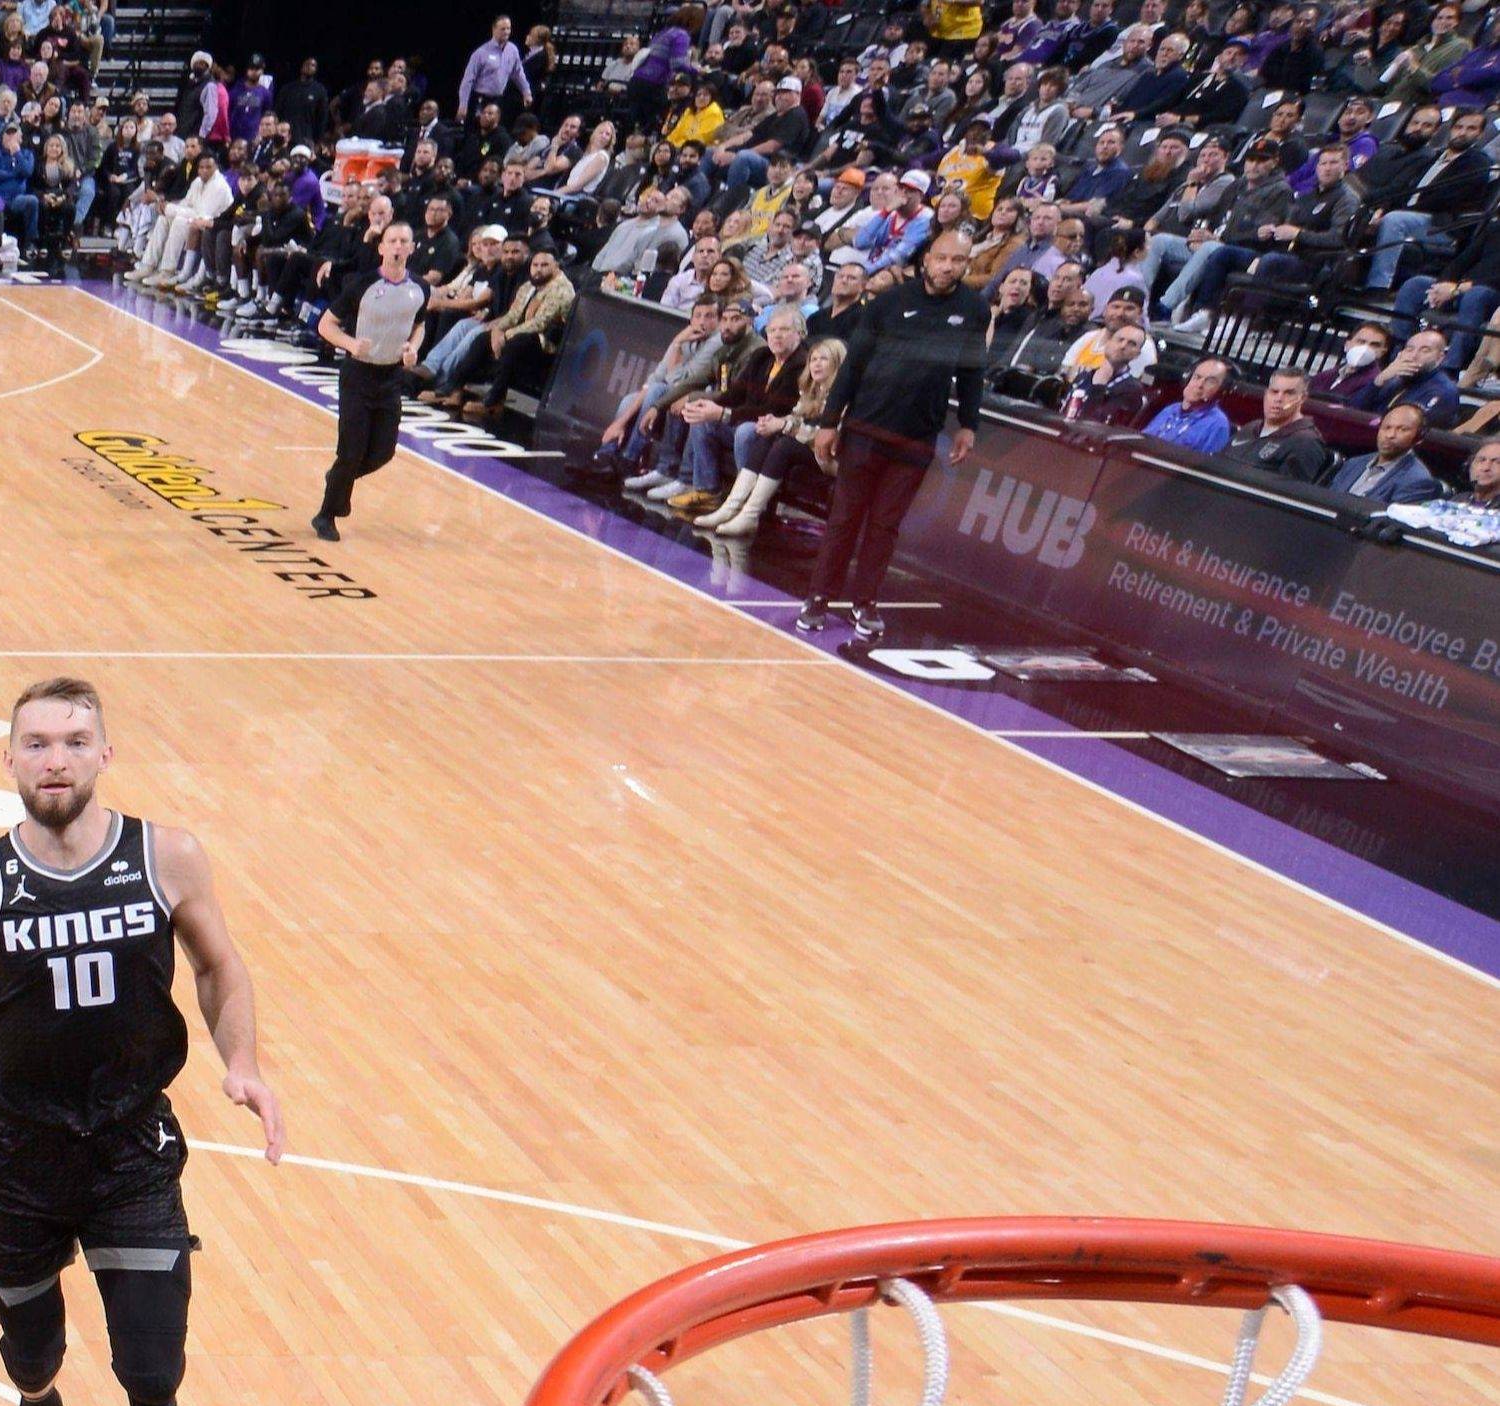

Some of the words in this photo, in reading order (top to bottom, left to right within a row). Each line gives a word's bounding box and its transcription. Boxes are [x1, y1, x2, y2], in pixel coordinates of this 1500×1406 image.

[957, 468, 1098, 570] HUB
[192, 514, 377, 599] CENTER
[1123, 522, 1169, 562] Risk
[1176, 540, 1193, 567] &
[1195, 546, 1312, 607] Insurance
[1328, 591, 1466, 661] Employee
[1108, 562, 1232, 627] Retirement
[1235, 609, 1253, 636] &
[1256, 616, 1347, 670] Private
[1354, 649, 1450, 709] Wealth
[6, 859, 18, 874] 6
[104, 870, 142, 886] dialpad
[2, 901, 155, 952] KINGS
[47, 951, 116, 1010] 10
